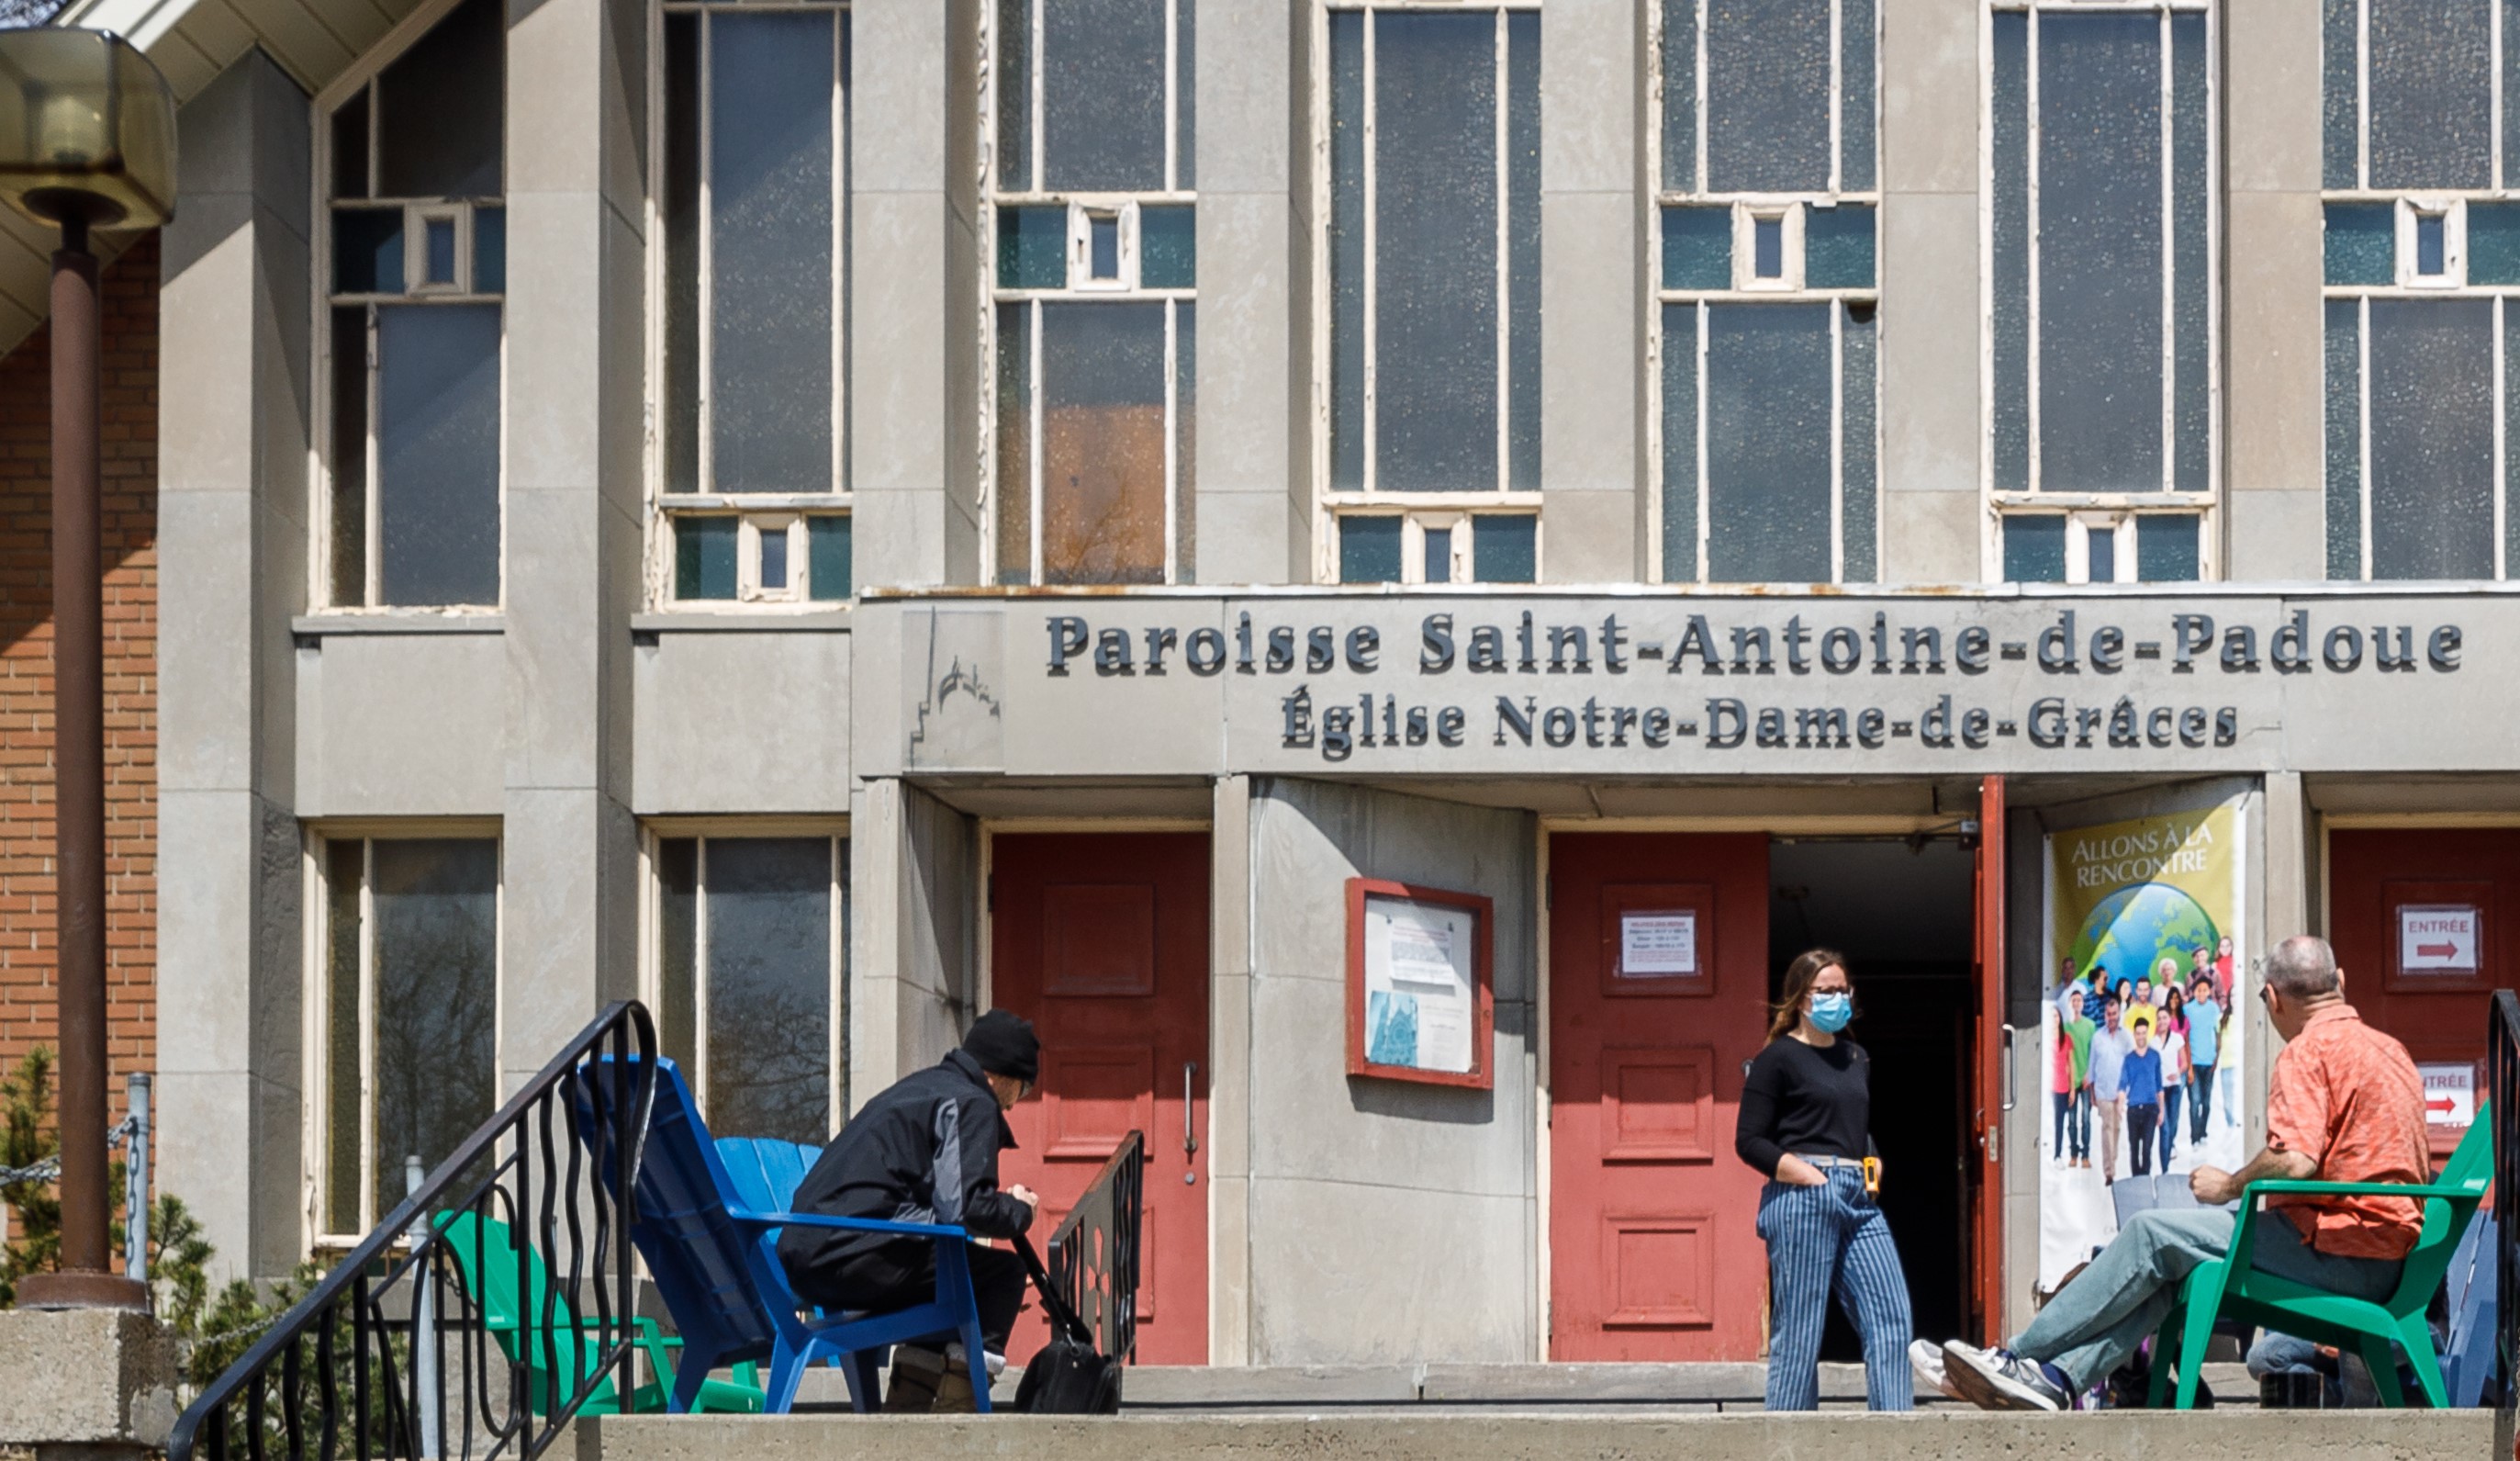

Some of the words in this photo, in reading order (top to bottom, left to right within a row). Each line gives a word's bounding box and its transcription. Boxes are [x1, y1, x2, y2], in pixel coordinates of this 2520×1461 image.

[1046, 610, 1381, 678] Paroisse
[1419, 609, 2463, 676] Saint-Antoine-de-Padoue
[1281, 684, 1466, 760] Église
[1494, 693, 2238, 749] Notre-Dame-de-Grâces
[2072, 831, 2158, 863] ALLONS
[2163, 822, 2179, 849] À
[2185, 823, 2213, 847] LA
[2077, 849, 2207, 888] RENCONTRE
[2408, 918, 2469, 934] ENTRÉE
[2423, 1073, 2468, 1088] TRÉE
